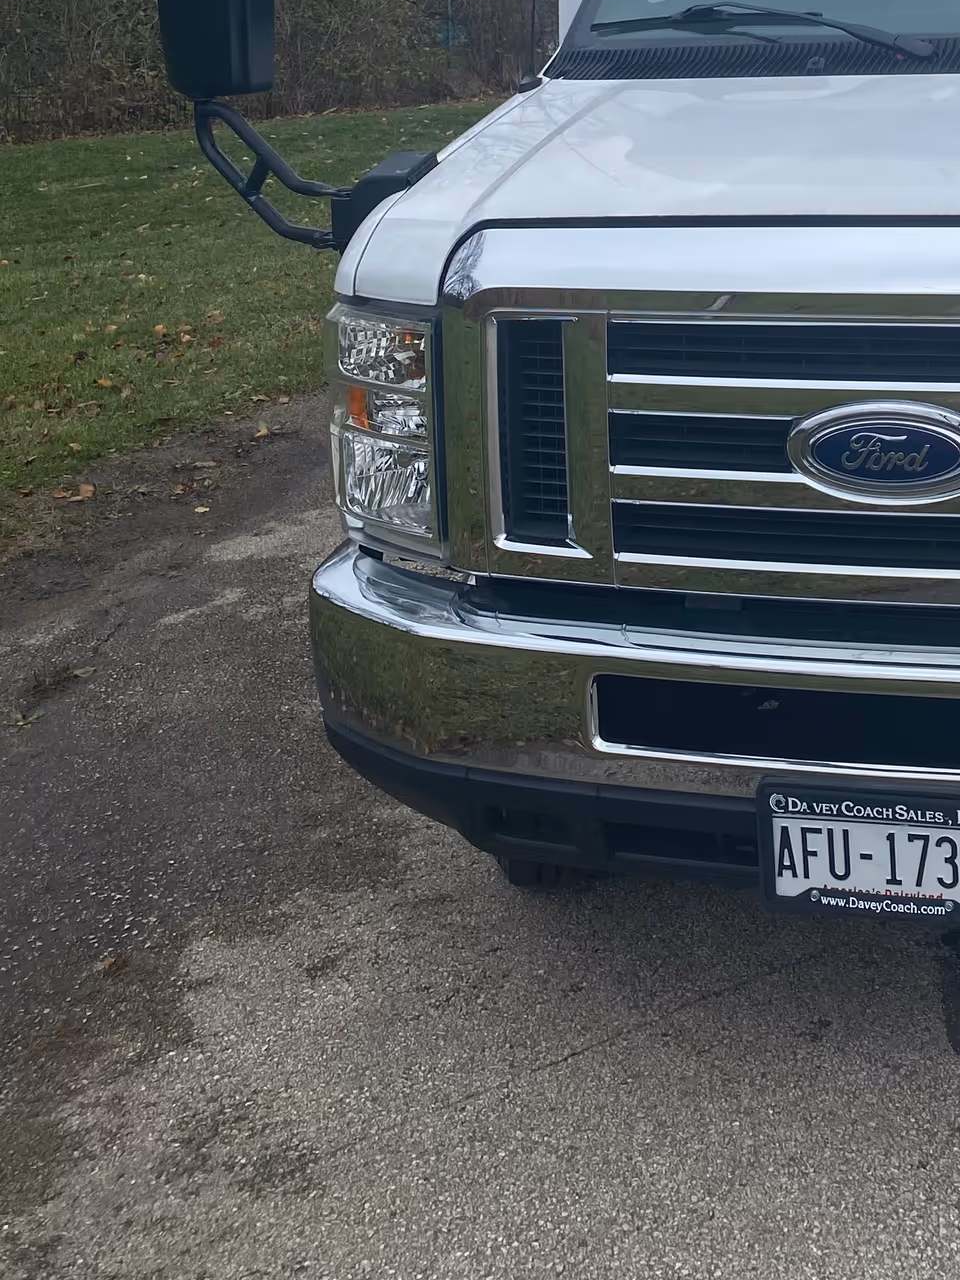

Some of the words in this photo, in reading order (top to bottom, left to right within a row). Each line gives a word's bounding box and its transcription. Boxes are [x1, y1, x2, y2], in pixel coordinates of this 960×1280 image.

[841, 432, 930, 471] Ford
[841, 801, 892, 819] COACH
[823, 884, 882, 897] Arica's
[820, 895, 946, 915] www.DaveyCoach.com
